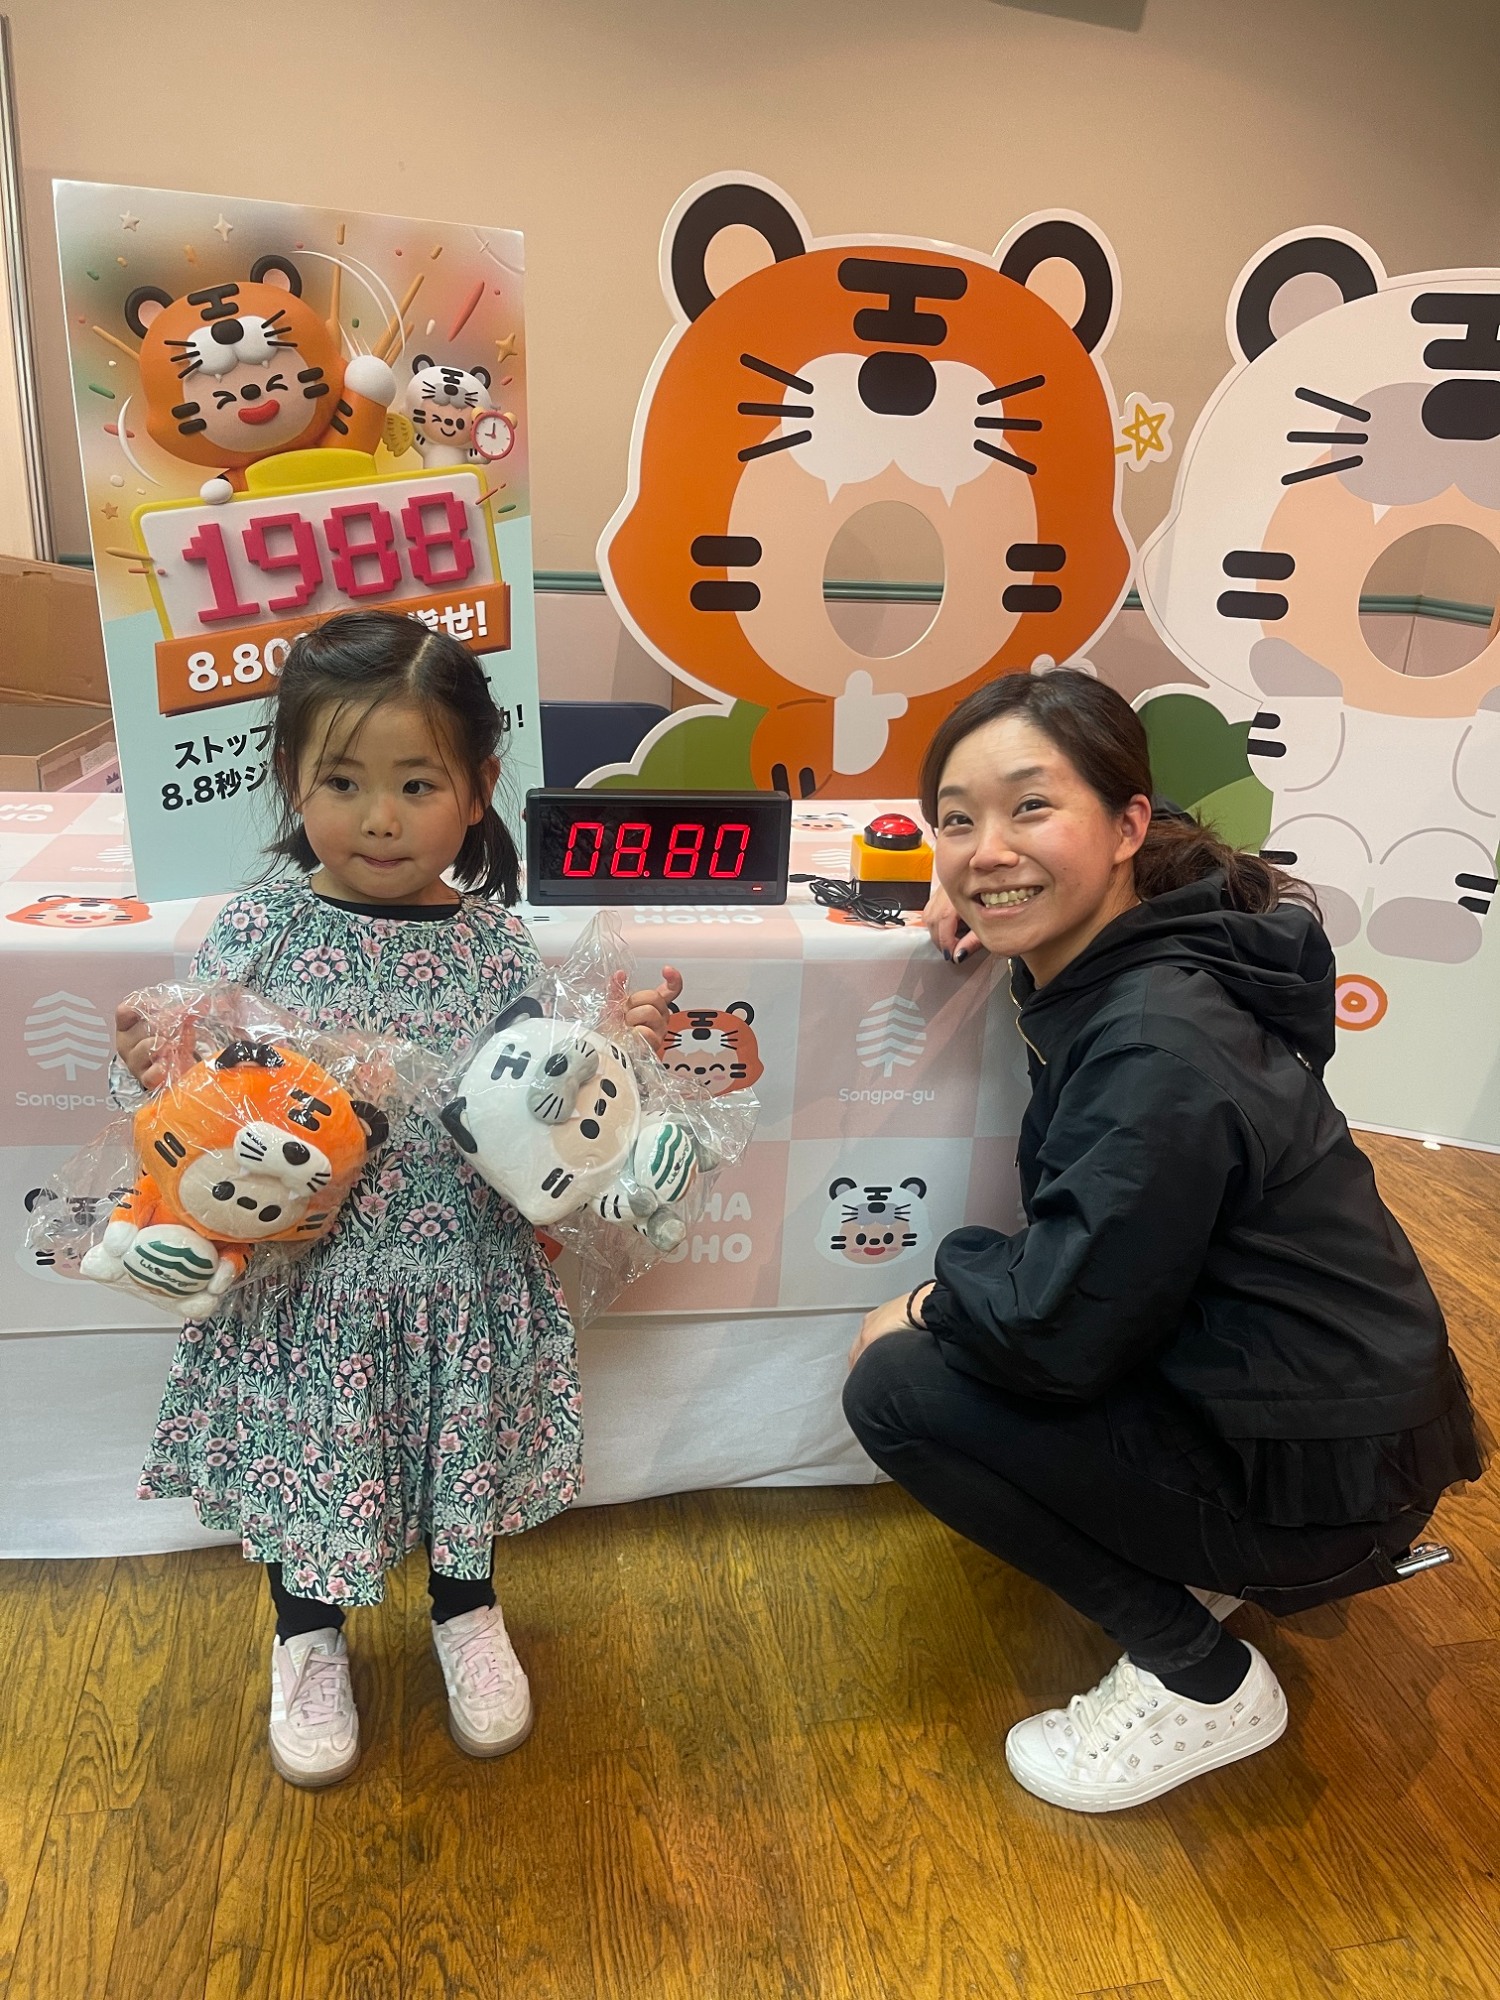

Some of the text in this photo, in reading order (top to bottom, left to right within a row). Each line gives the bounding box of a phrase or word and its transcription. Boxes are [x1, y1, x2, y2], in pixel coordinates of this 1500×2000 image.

[182, 491, 475, 623] 1988
[187, 633, 308, 692] 8.80
[562, 822, 751, 878] 08.80
[633, 914, 765, 925] HOHO
[838, 1088, 935, 1105] Songpa-gu
